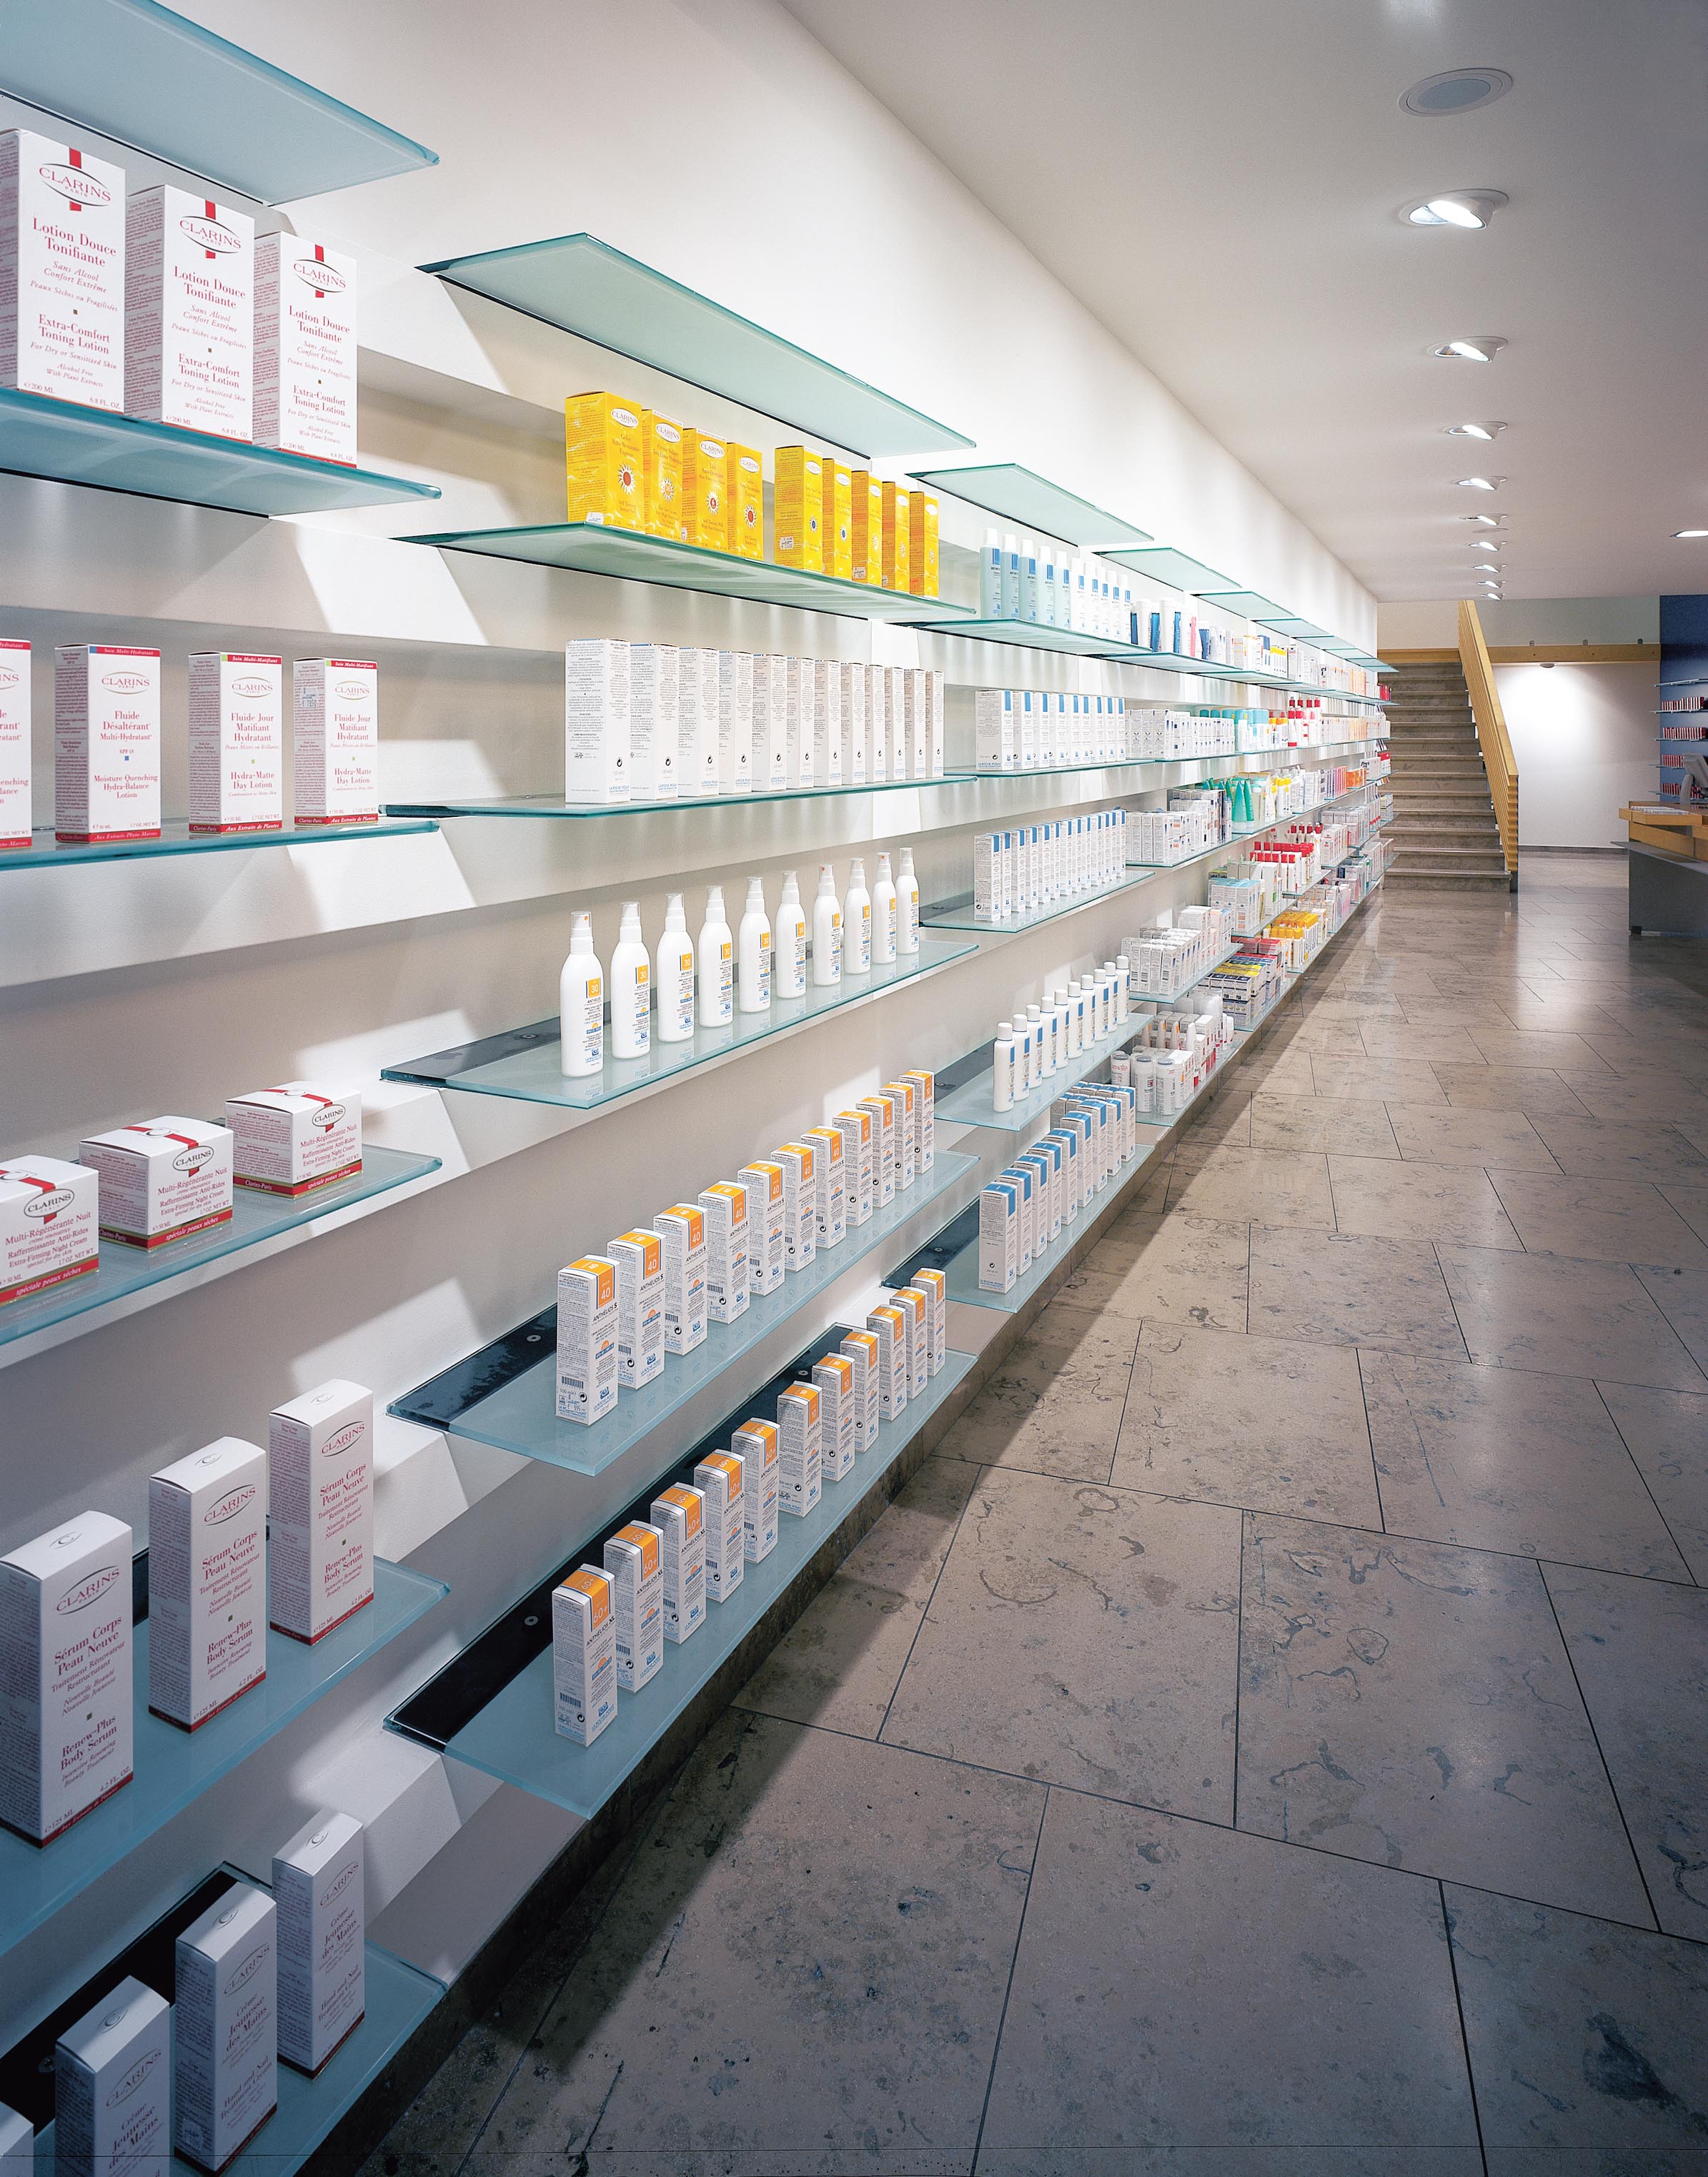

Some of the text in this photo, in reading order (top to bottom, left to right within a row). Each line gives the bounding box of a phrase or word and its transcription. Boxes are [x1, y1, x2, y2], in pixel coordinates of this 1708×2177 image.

[39, 167, 111, 202] CLARINS
[34, 217, 116, 256] Lotion Douce
[179, 220, 241, 249] CLARINS
[44, 236, 106, 267] Tonifiante
[44, 268, 106, 294] Confort Extrême
[53, 261, 99, 281] Sans Alcool
[174, 266, 246, 298] Lotion Douce
[294, 263, 346, 288] CLARINS
[30, 280, 51, 292] Peaux
[184, 282, 237, 309] Tonifiante
[39, 314, 109, 343] Extra-Comfort
[289, 305, 350, 334] Lotion Douce
[39, 327, 109, 354] Toning Lotion
[297, 320, 342, 343] Tonifiante
[46, 346, 58, 354] Dry
[103, 361, 116, 370] Skin
[179, 353, 240, 377] Extra-Comfort
[179, 364, 239, 388] Toning Lotion
[294, 385, 346, 407] Extra-Comfort
[294, 395, 345, 416] Toning Lotion
[612, 412, 637, 424] CLARINS
[657, 426, 680, 440] CLARINS
[701, 443, 723, 454] CLARINS
[740, 460, 759, 469] CLARINS
[101, 678, 150, 686] CLARINS
[103, 721, 149, 730] Désaltérant
[115, 711, 139, 720] Fluide
[231, 713, 255, 722] Fluide
[334, 713, 371, 723] Fluide Jour
[100, 733, 150, 743] Multi-Hydratant
[234, 733, 271, 743] Hydratant
[337, 733, 369, 743] Hydratant
[125, 775, 158, 783] Quenching
[231, 771, 274, 781] Hydra-Matte
[334, 768, 372, 777] Hydra-Matte
[337, 777, 349, 786] Day
[104, 783, 149, 792] Hydra-Balance
[234, 781, 247, 790] Day
[725, 948, 730, 956] 30
[591, 985, 598, 993] 30
[314, 1109, 343, 1123] CLARINS
[347, 1124, 357, 1133] Nuit
[176, 1151, 211, 1166] CLARINS
[302, 1136, 355, 1159] Raffermissante Anti-Rides
[303, 1154, 330, 1166] Extra-Firming
[332, 1149, 342, 1158] Night
[158, 1167, 227, 1195] Multi-Régénérante Nuit
[245, 1180, 272, 1191] Clarins-Paris
[28, 1194, 71, 1213] CLARINS
[160, 1181, 225, 1207] Raffermissante Anti-Rides
[162, 1190, 224, 1215] Extra-Firming Night Cream
[735, 1208, 743, 1219] 40
[6, 1212, 91, 1245] Multi-Régénérante Nuit
[692, 1231, 700, 1243] 40
[8, 1227, 89, 1259] Raffermissante Anti-Rides
[9, 1237, 87, 1268] Extra-Firming Night Cream
[647, 1259, 657, 1271] 40
[43, 1272, 61, 1287] peaux
[640, 1275, 660, 1292] ANTHELIOS
[600, 1287, 610, 1299] 40
[593, 1304, 614, 1322] ANTHELIOS
[322, 1424, 365, 1454] CLARINS
[320, 1464, 366, 1497] Sérum Corps
[322, 1475, 364, 1507] Peau Neuve
[204, 1487, 256, 1522] CLARINS
[632, 1531, 645, 1542] 60+
[687, 1518, 700, 1533] 60+
[202, 1531, 257, 1569] Sérum Corps
[681, 1529, 706, 1554] ANTHELIOS XL
[205, 1543, 254, 1580] Peau Neuve
[324, 1553, 363, 1584] Body Serum
[325, 1544, 362, 1573] Renew-Plus
[644, 1557, 657, 1574] 60+
[56, 1568, 120, 1611] CLARINS
[582, 1578, 595, 1590] 60+
[636, 1569, 663, 1595] ANTHELIOS XL
[594, 1605, 607, 1623] 60+
[54, 1616, 121, 1665] Sérum Corps
[208, 1619, 252, 1654] Renew-Plus
[586, 1616, 615, 1647] ANTHELIOS XL
[57, 1631, 119, 1676] Peau Neuve
[207, 1629, 253, 1665] Body Serum
[60, 1725, 117, 1771] Body Serum
[62, 1715, 116, 1758] Renew-Plus
[320, 1864, 359, 1906] CLARINS
[224, 1947, 269, 1994] CLARINS
[106, 2049, 162, 2107] CLARINS
